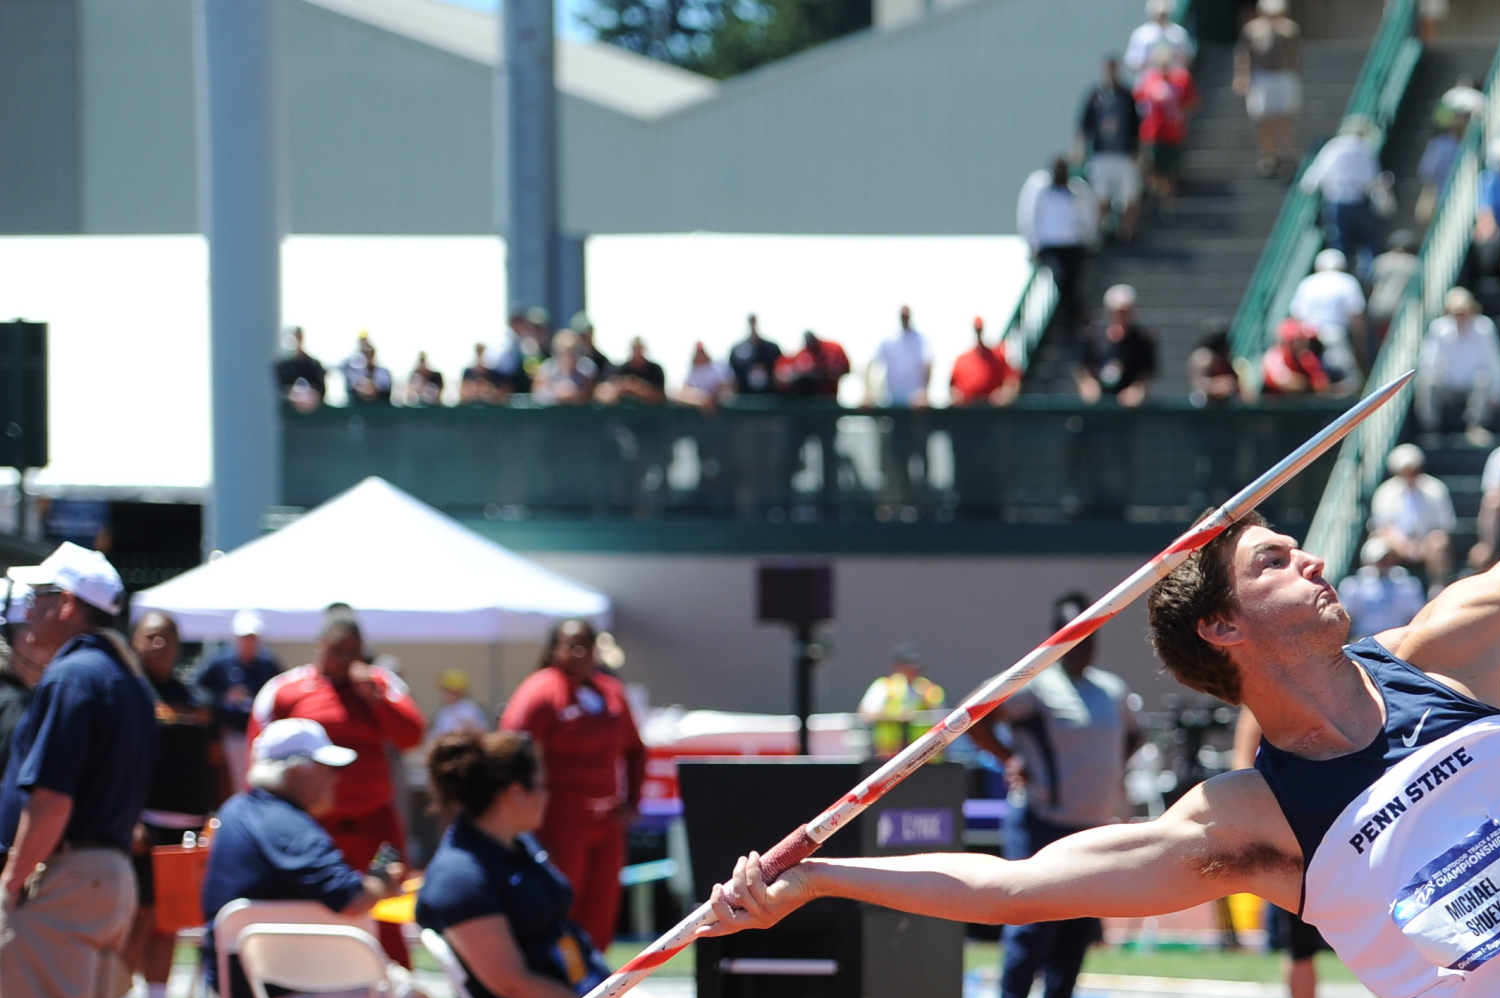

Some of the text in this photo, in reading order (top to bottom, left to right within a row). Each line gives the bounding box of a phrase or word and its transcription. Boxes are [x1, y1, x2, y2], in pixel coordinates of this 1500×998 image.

[1349, 746, 1474, 854] PENN STATE
[1442, 853, 1469, 873] OUTDOOR
[1467, 839, 1487, 854] TRACK
